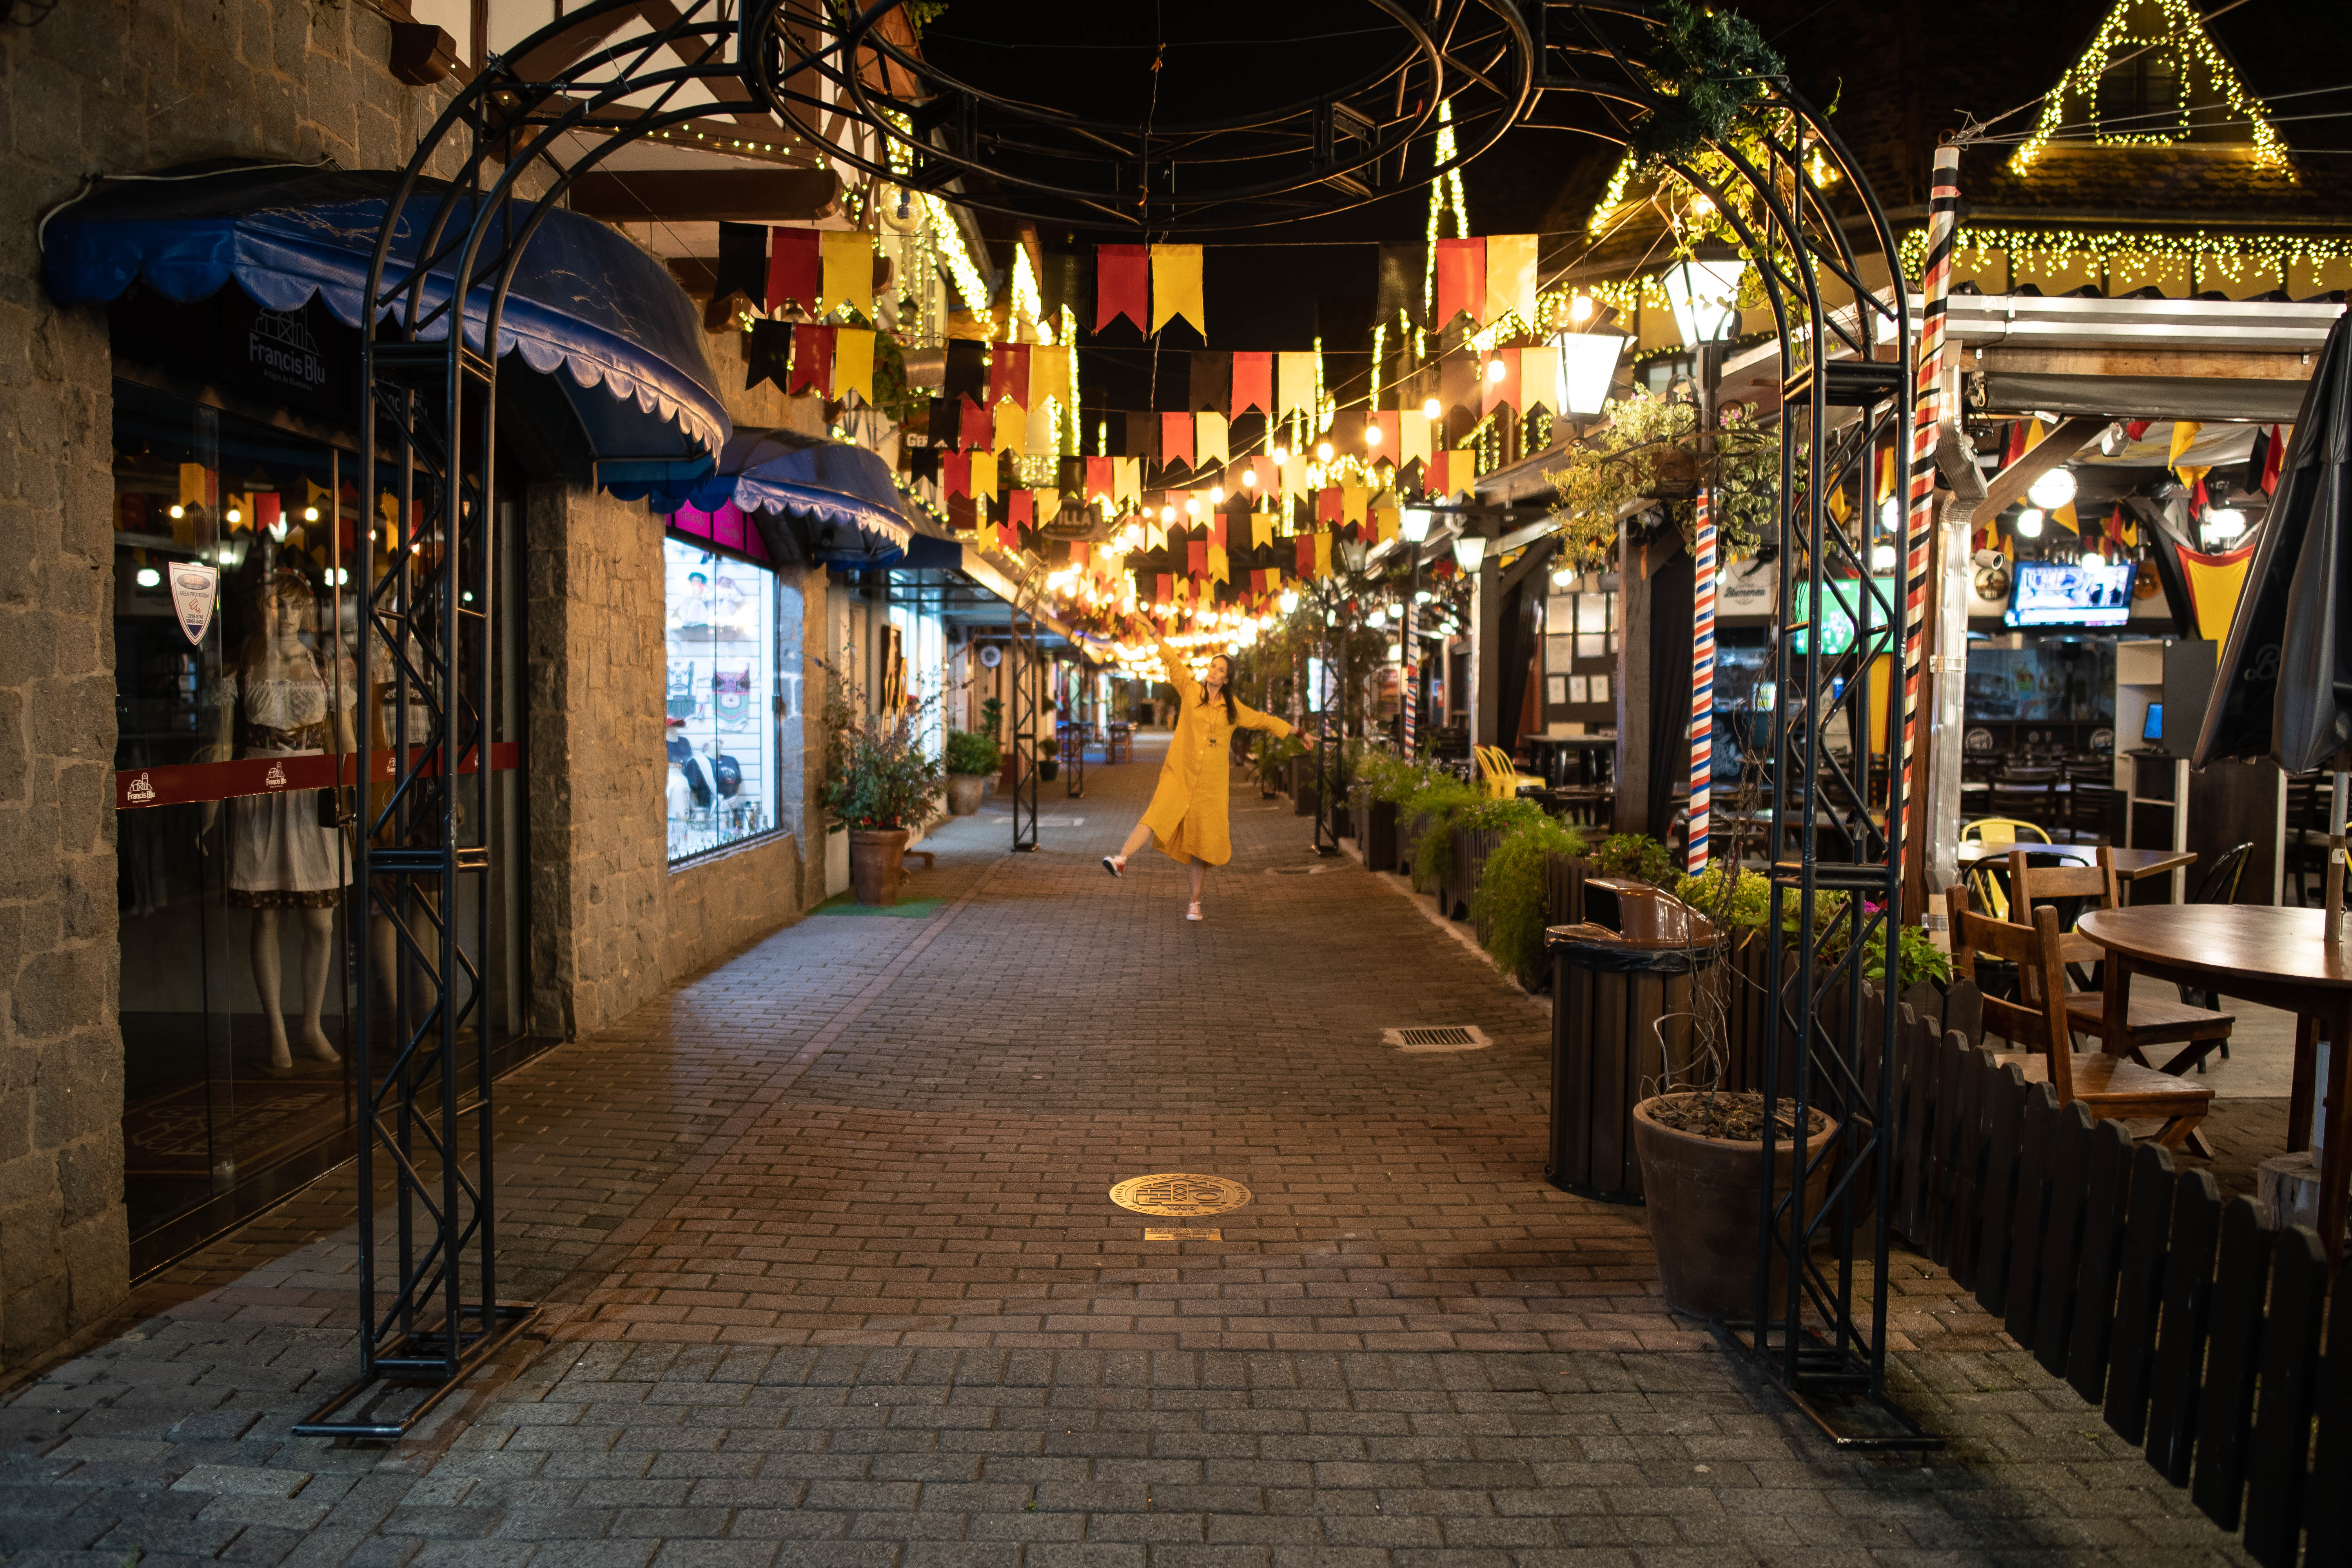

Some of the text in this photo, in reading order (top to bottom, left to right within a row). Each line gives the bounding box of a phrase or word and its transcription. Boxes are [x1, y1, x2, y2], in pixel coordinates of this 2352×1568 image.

[249, 332, 325, 385] Francis Blu
[127, 790, 155, 800] Francis Blu
